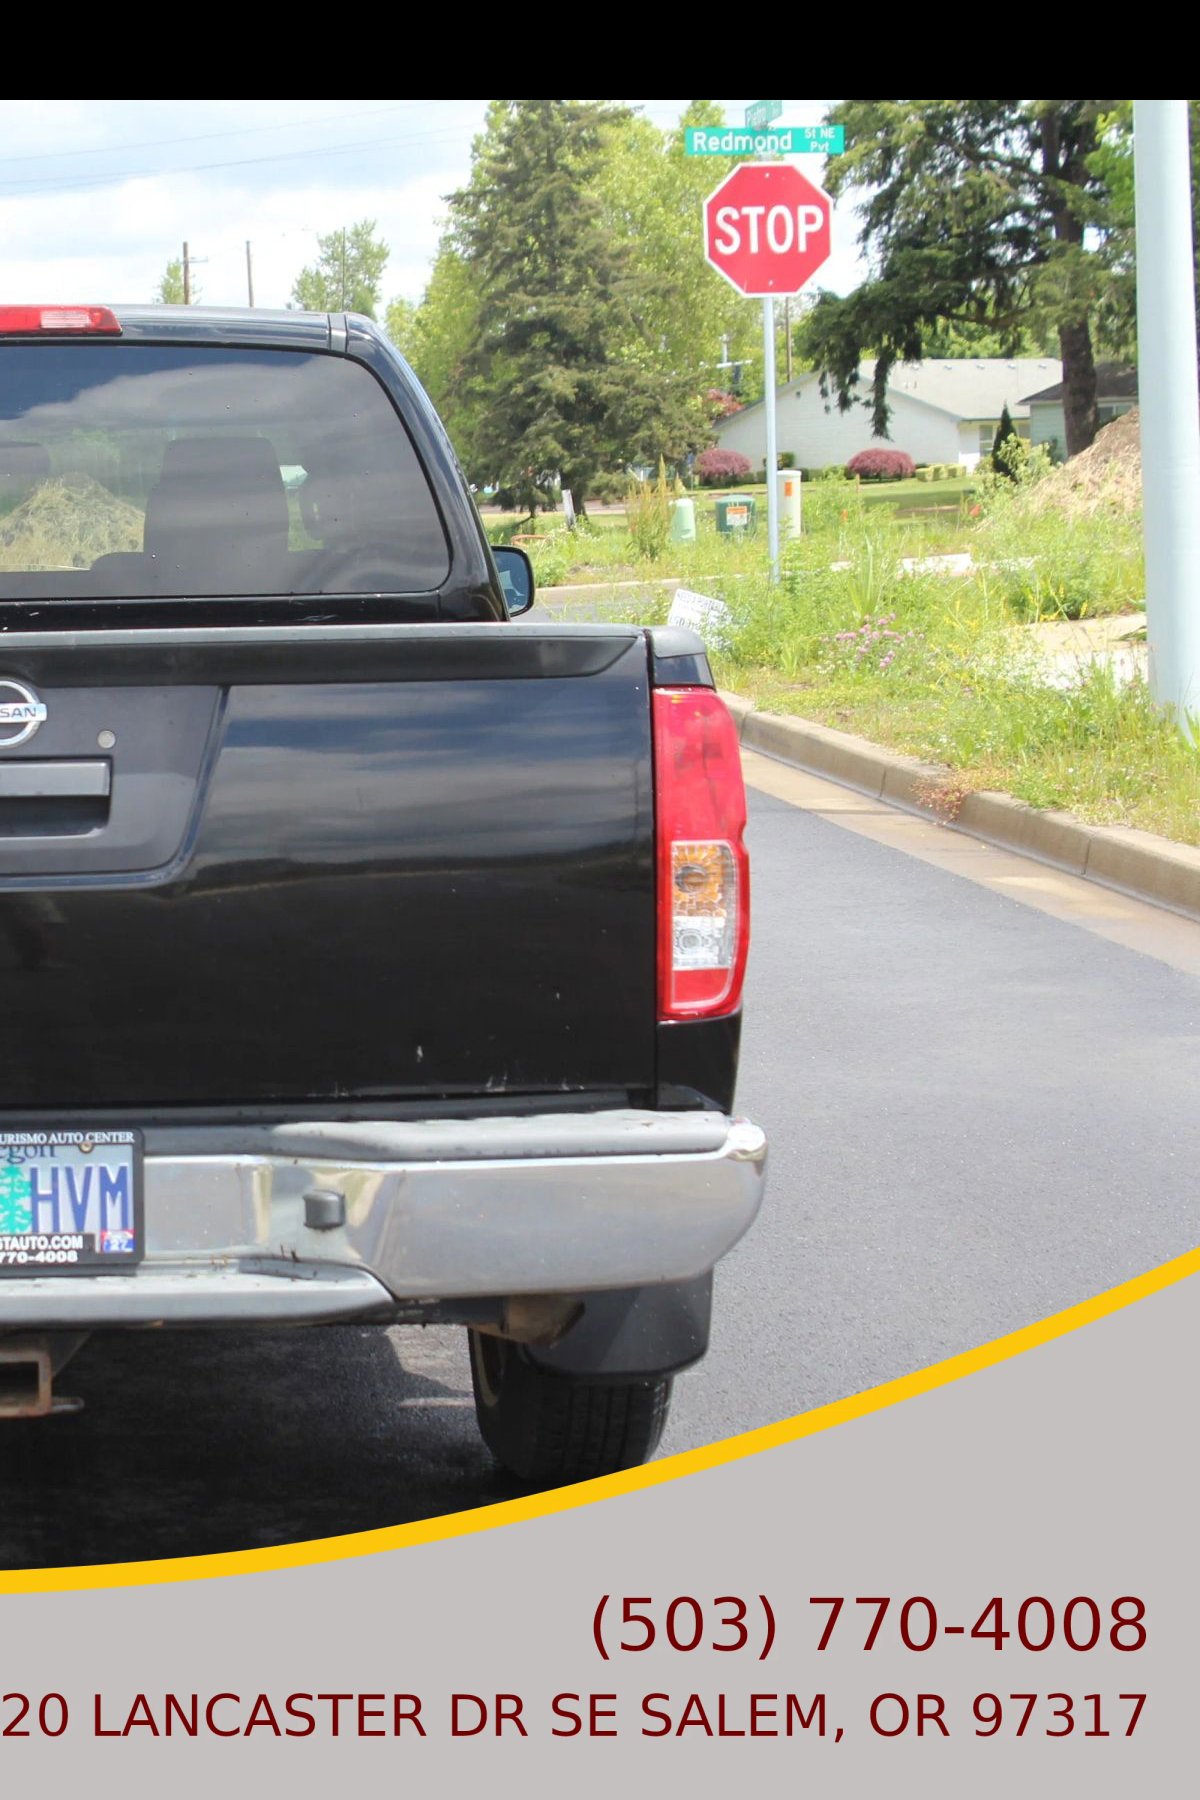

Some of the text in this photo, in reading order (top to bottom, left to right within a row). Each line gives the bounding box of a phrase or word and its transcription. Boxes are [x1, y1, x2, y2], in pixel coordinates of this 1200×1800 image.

[693, 128, 835, 151] Redmond St NE
[810, 141, 829, 152] Pvt
[715, 205, 824, 255] STOP
[48, 1132, 84, 1144] AUTO
[85, 1131, 135, 1143] CENTER
[30, 1165, 128, 1233] HVM
